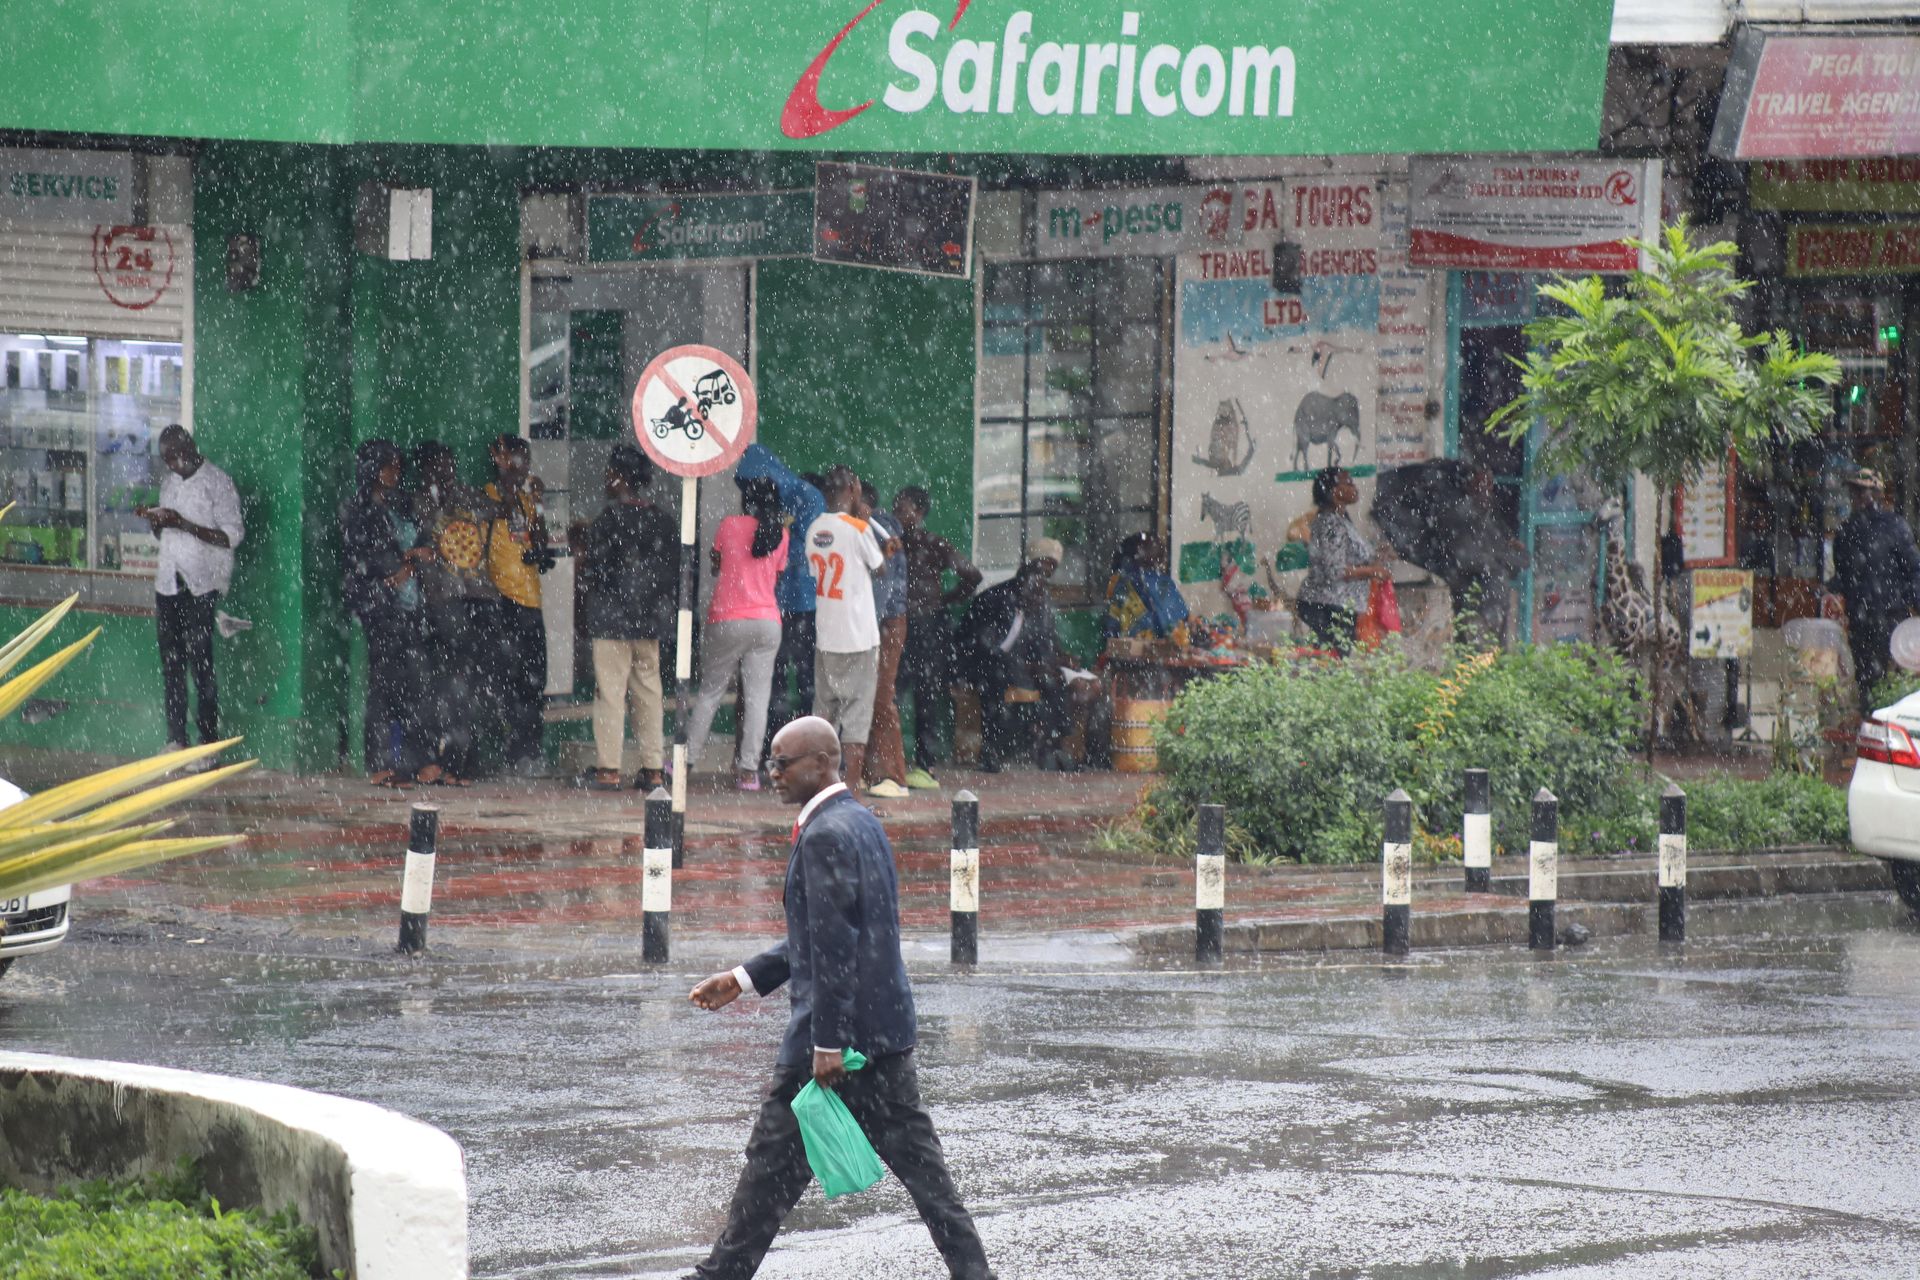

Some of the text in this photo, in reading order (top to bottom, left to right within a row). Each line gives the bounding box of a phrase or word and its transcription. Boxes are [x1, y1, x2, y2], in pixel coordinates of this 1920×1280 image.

[882, 10, 1297, 117] Safaricom
[1807, 53, 1865, 77] PEGA
[1755, 92, 1834, 116] TRAVEL
[10, 172, 119, 201] SERVICE
[1292, 185, 1373, 228] TOURS
[115, 245, 155, 272] 24
[1199, 251, 1272, 280] TRAVEL
[1263, 301, 1309, 326] LTD.
